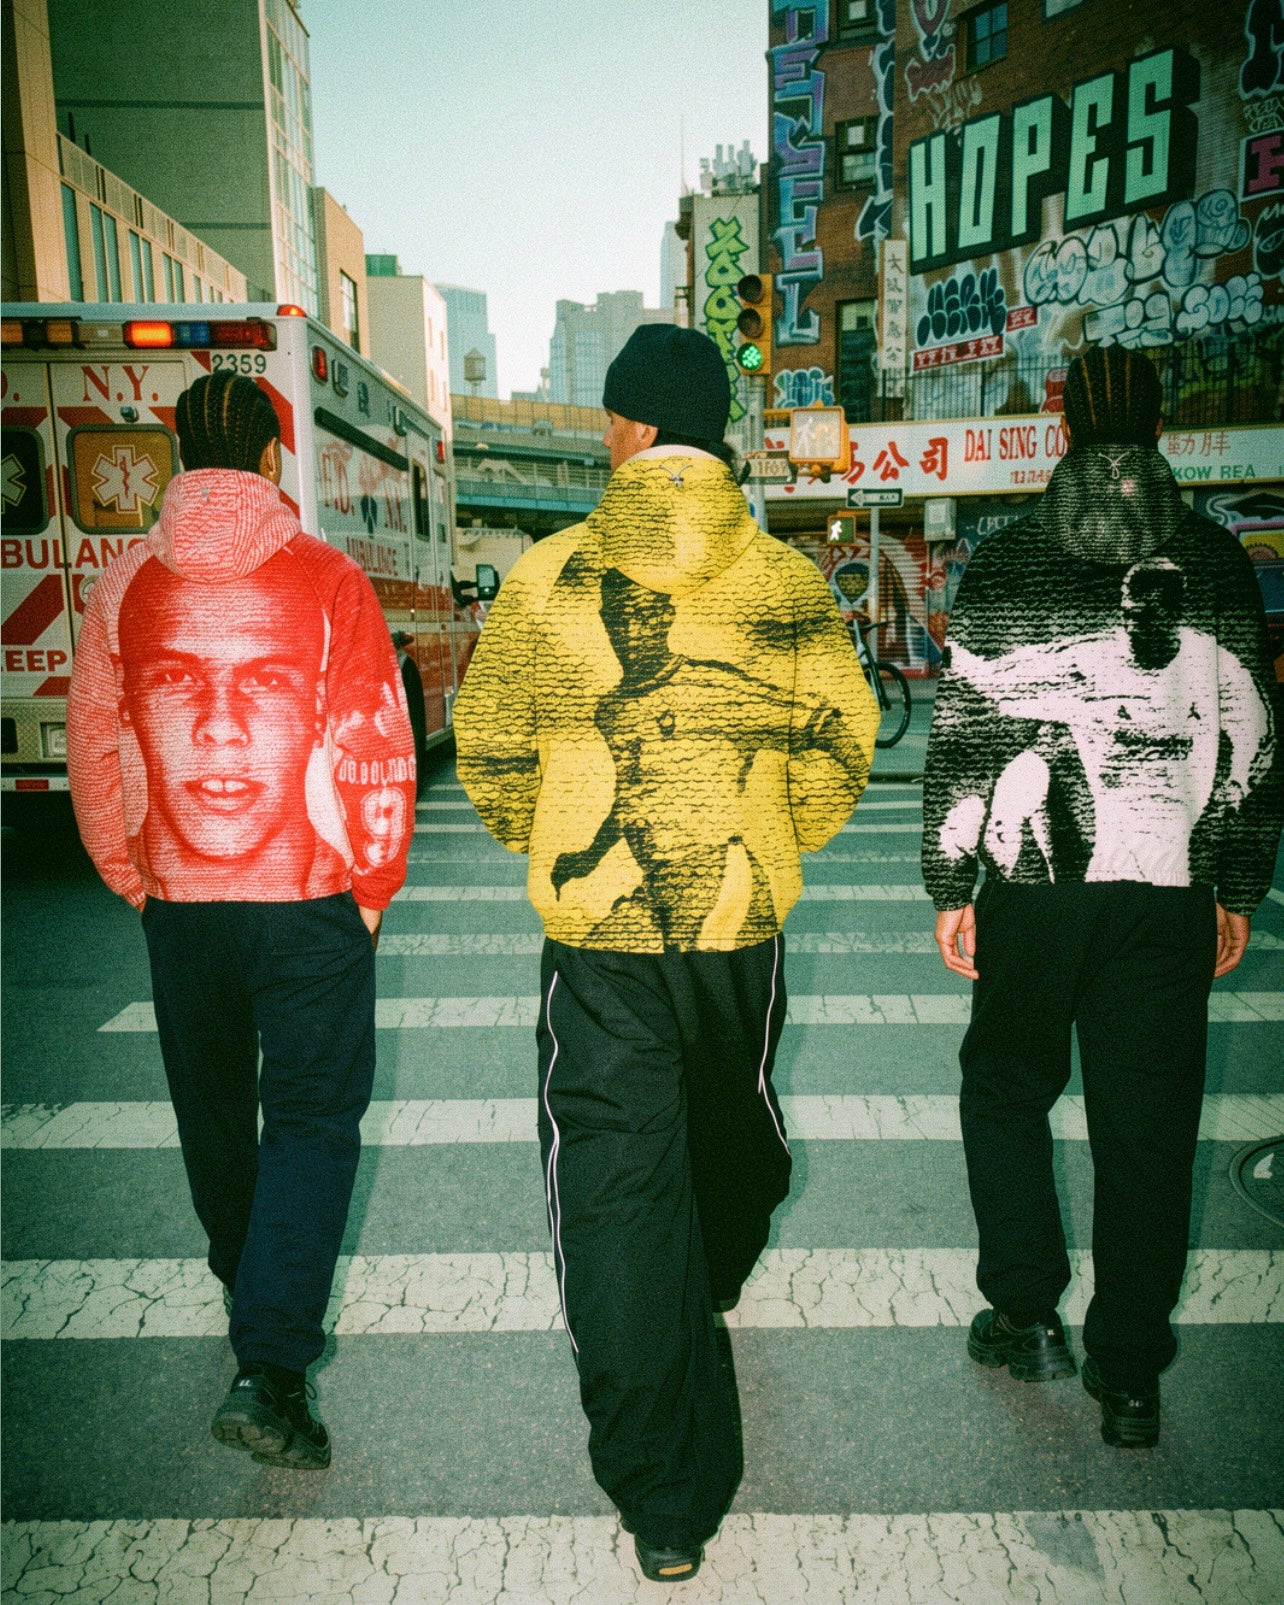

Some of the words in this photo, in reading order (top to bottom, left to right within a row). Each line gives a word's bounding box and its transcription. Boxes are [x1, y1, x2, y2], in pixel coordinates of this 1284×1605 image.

[910, 50, 1173, 262] HOPES
[211, 353, 267, 374] 2359
[81, 365, 159, 402] N.Y.
[963, 429, 992, 462] DAI
[999, 426, 1037, 461] SING
[1220, 463, 1256, 480] REA
